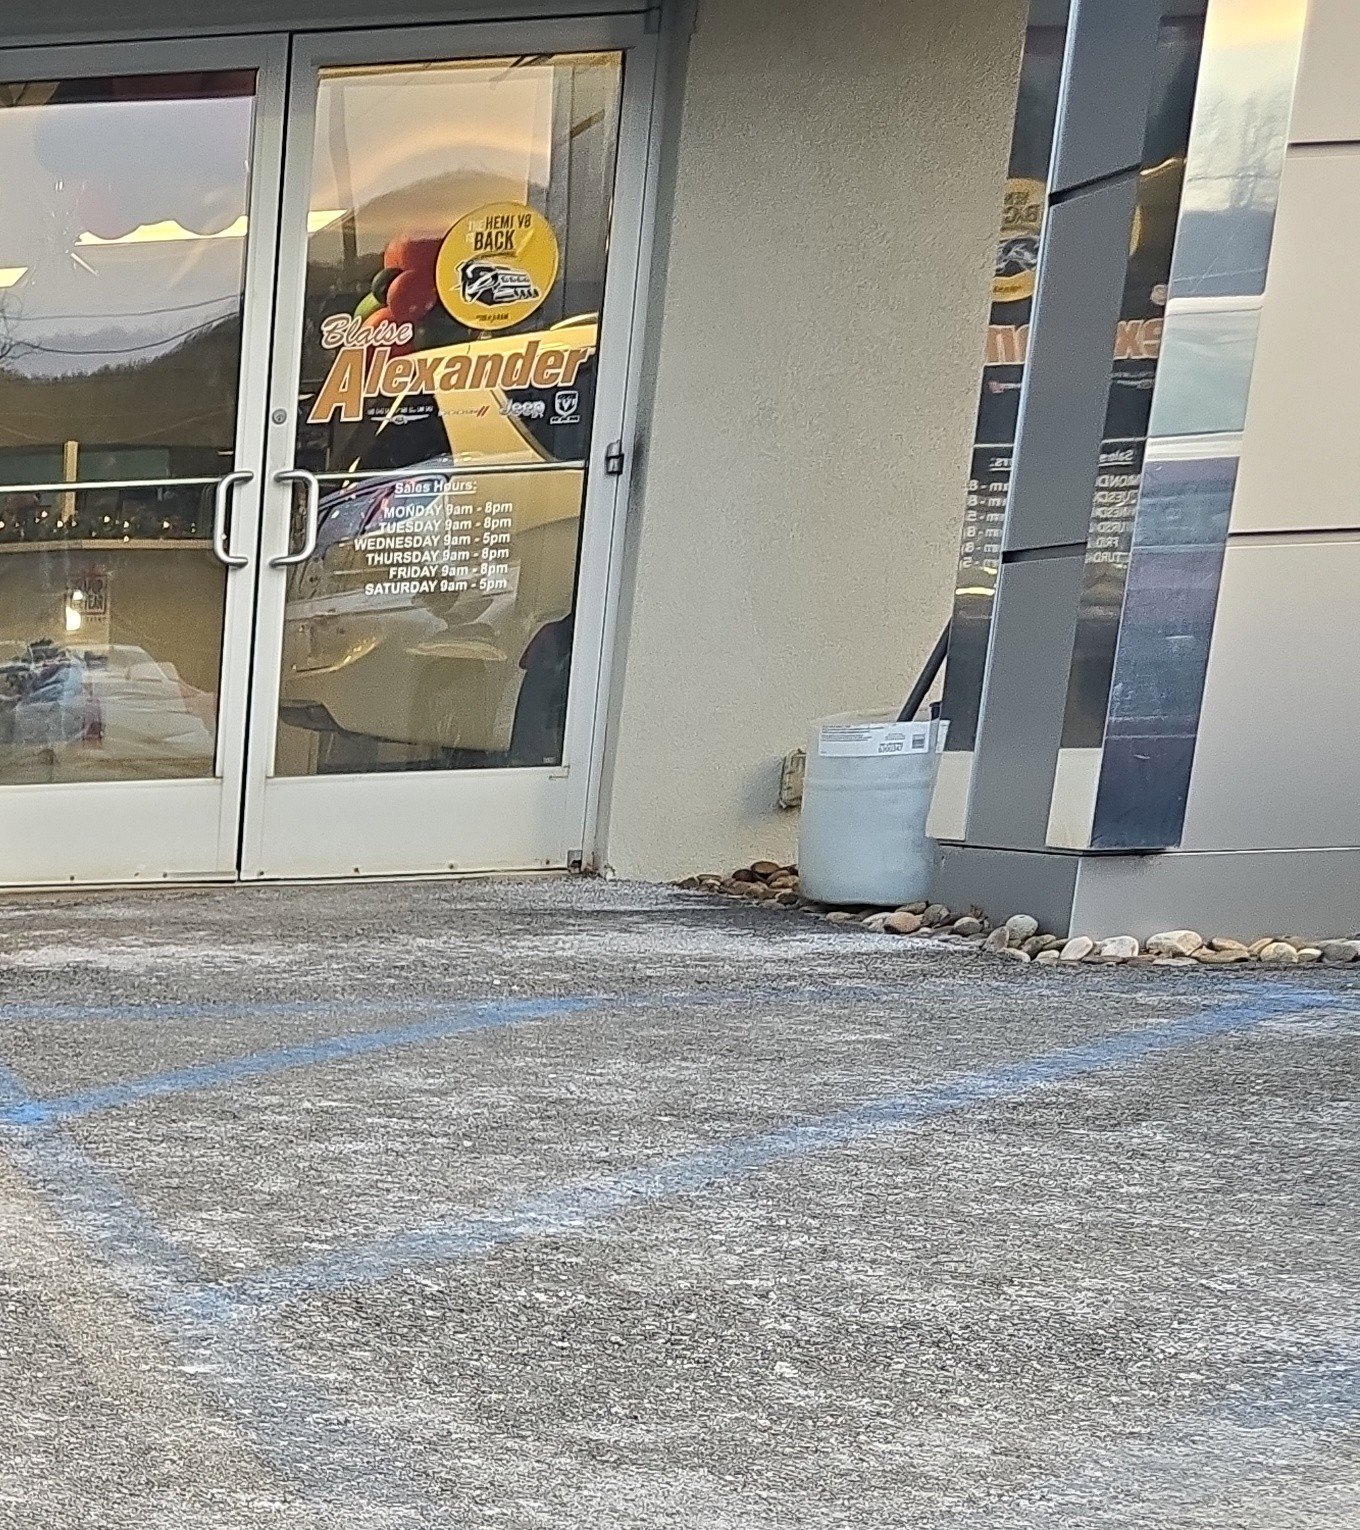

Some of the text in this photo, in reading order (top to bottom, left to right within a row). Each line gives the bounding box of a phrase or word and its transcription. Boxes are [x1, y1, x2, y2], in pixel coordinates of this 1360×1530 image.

[485, 214, 516, 231] HEMI
[517, 213, 532, 229] V8
[474, 229, 515, 252] BACK
[321, 314, 414, 349] Blaise
[306, 339, 596, 424] Alexander
[499, 399, 545, 419] Jeep
[394, 479, 477, 494] Sales Hours:
[383, 504, 442, 519] MONDAY
[445, 504, 473, 516] 9am
[484, 501, 513, 516] 8pm
[379, 520, 442, 534] TUESDAY
[444, 519, 472, 531] 9am
[483, 517, 512, 532] 8pm
[354, 534, 440, 551] WEDNESDAY
[443, 534, 471, 546] 9am
[482, 532, 510, 547] 5pm
[366, 550, 439, 566] THURSDAY
[442, 549, 470, 561] 9am
[481, 547, 509, 562] 8pm
[389, 565, 438, 579] FRIDAY
[441, 564, 468, 576] 9am
[480, 563, 508, 578] 8pm
[365, 580, 437, 596] SATURDAY
[440, 579, 467, 591] 9am
[479, 578, 507, 591] 5pm
